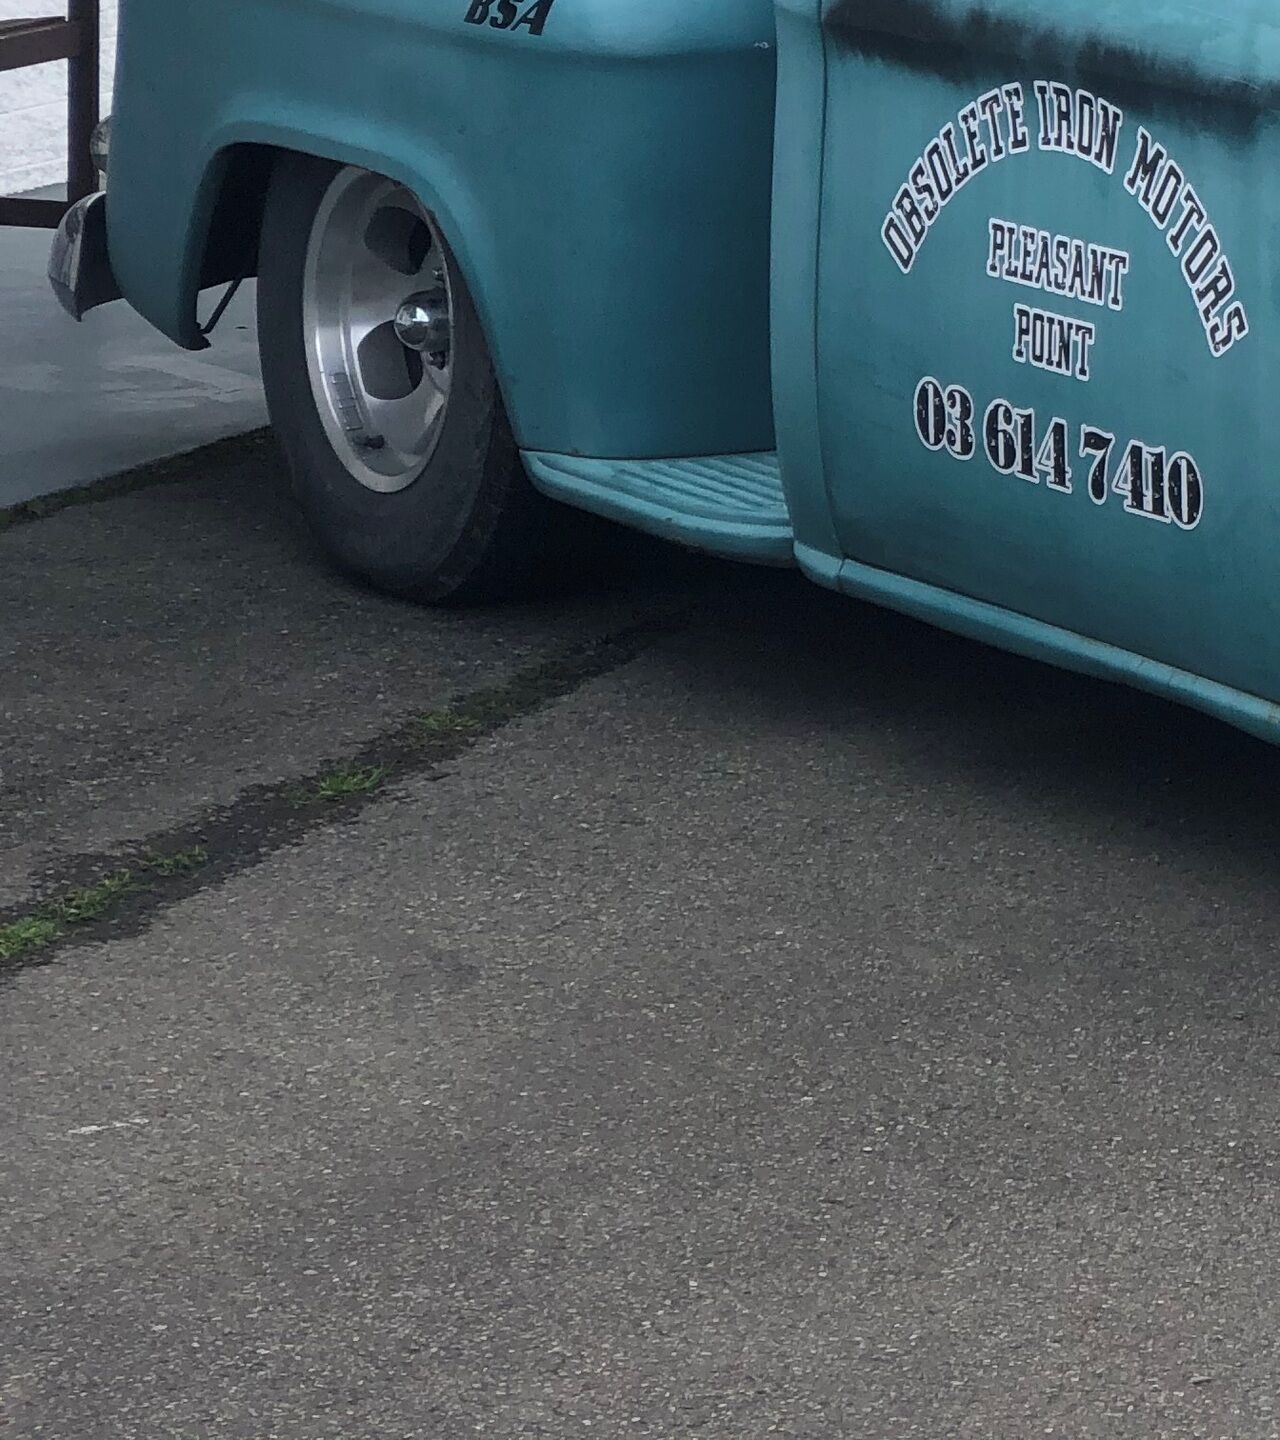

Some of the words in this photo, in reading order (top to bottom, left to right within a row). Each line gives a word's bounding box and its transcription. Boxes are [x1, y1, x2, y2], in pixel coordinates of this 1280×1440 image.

[882, 83, 1029, 273] OBSOLETE
[1034, 82, 1122, 174] IRON
[1124, 127, 1249, 357] MOTORS
[987, 218, 1128, 310] PLEASANT
[1014, 303, 1095, 381] POINT
[914, 377, 975, 460] 03
[984, 399, 1072, 494] 614
